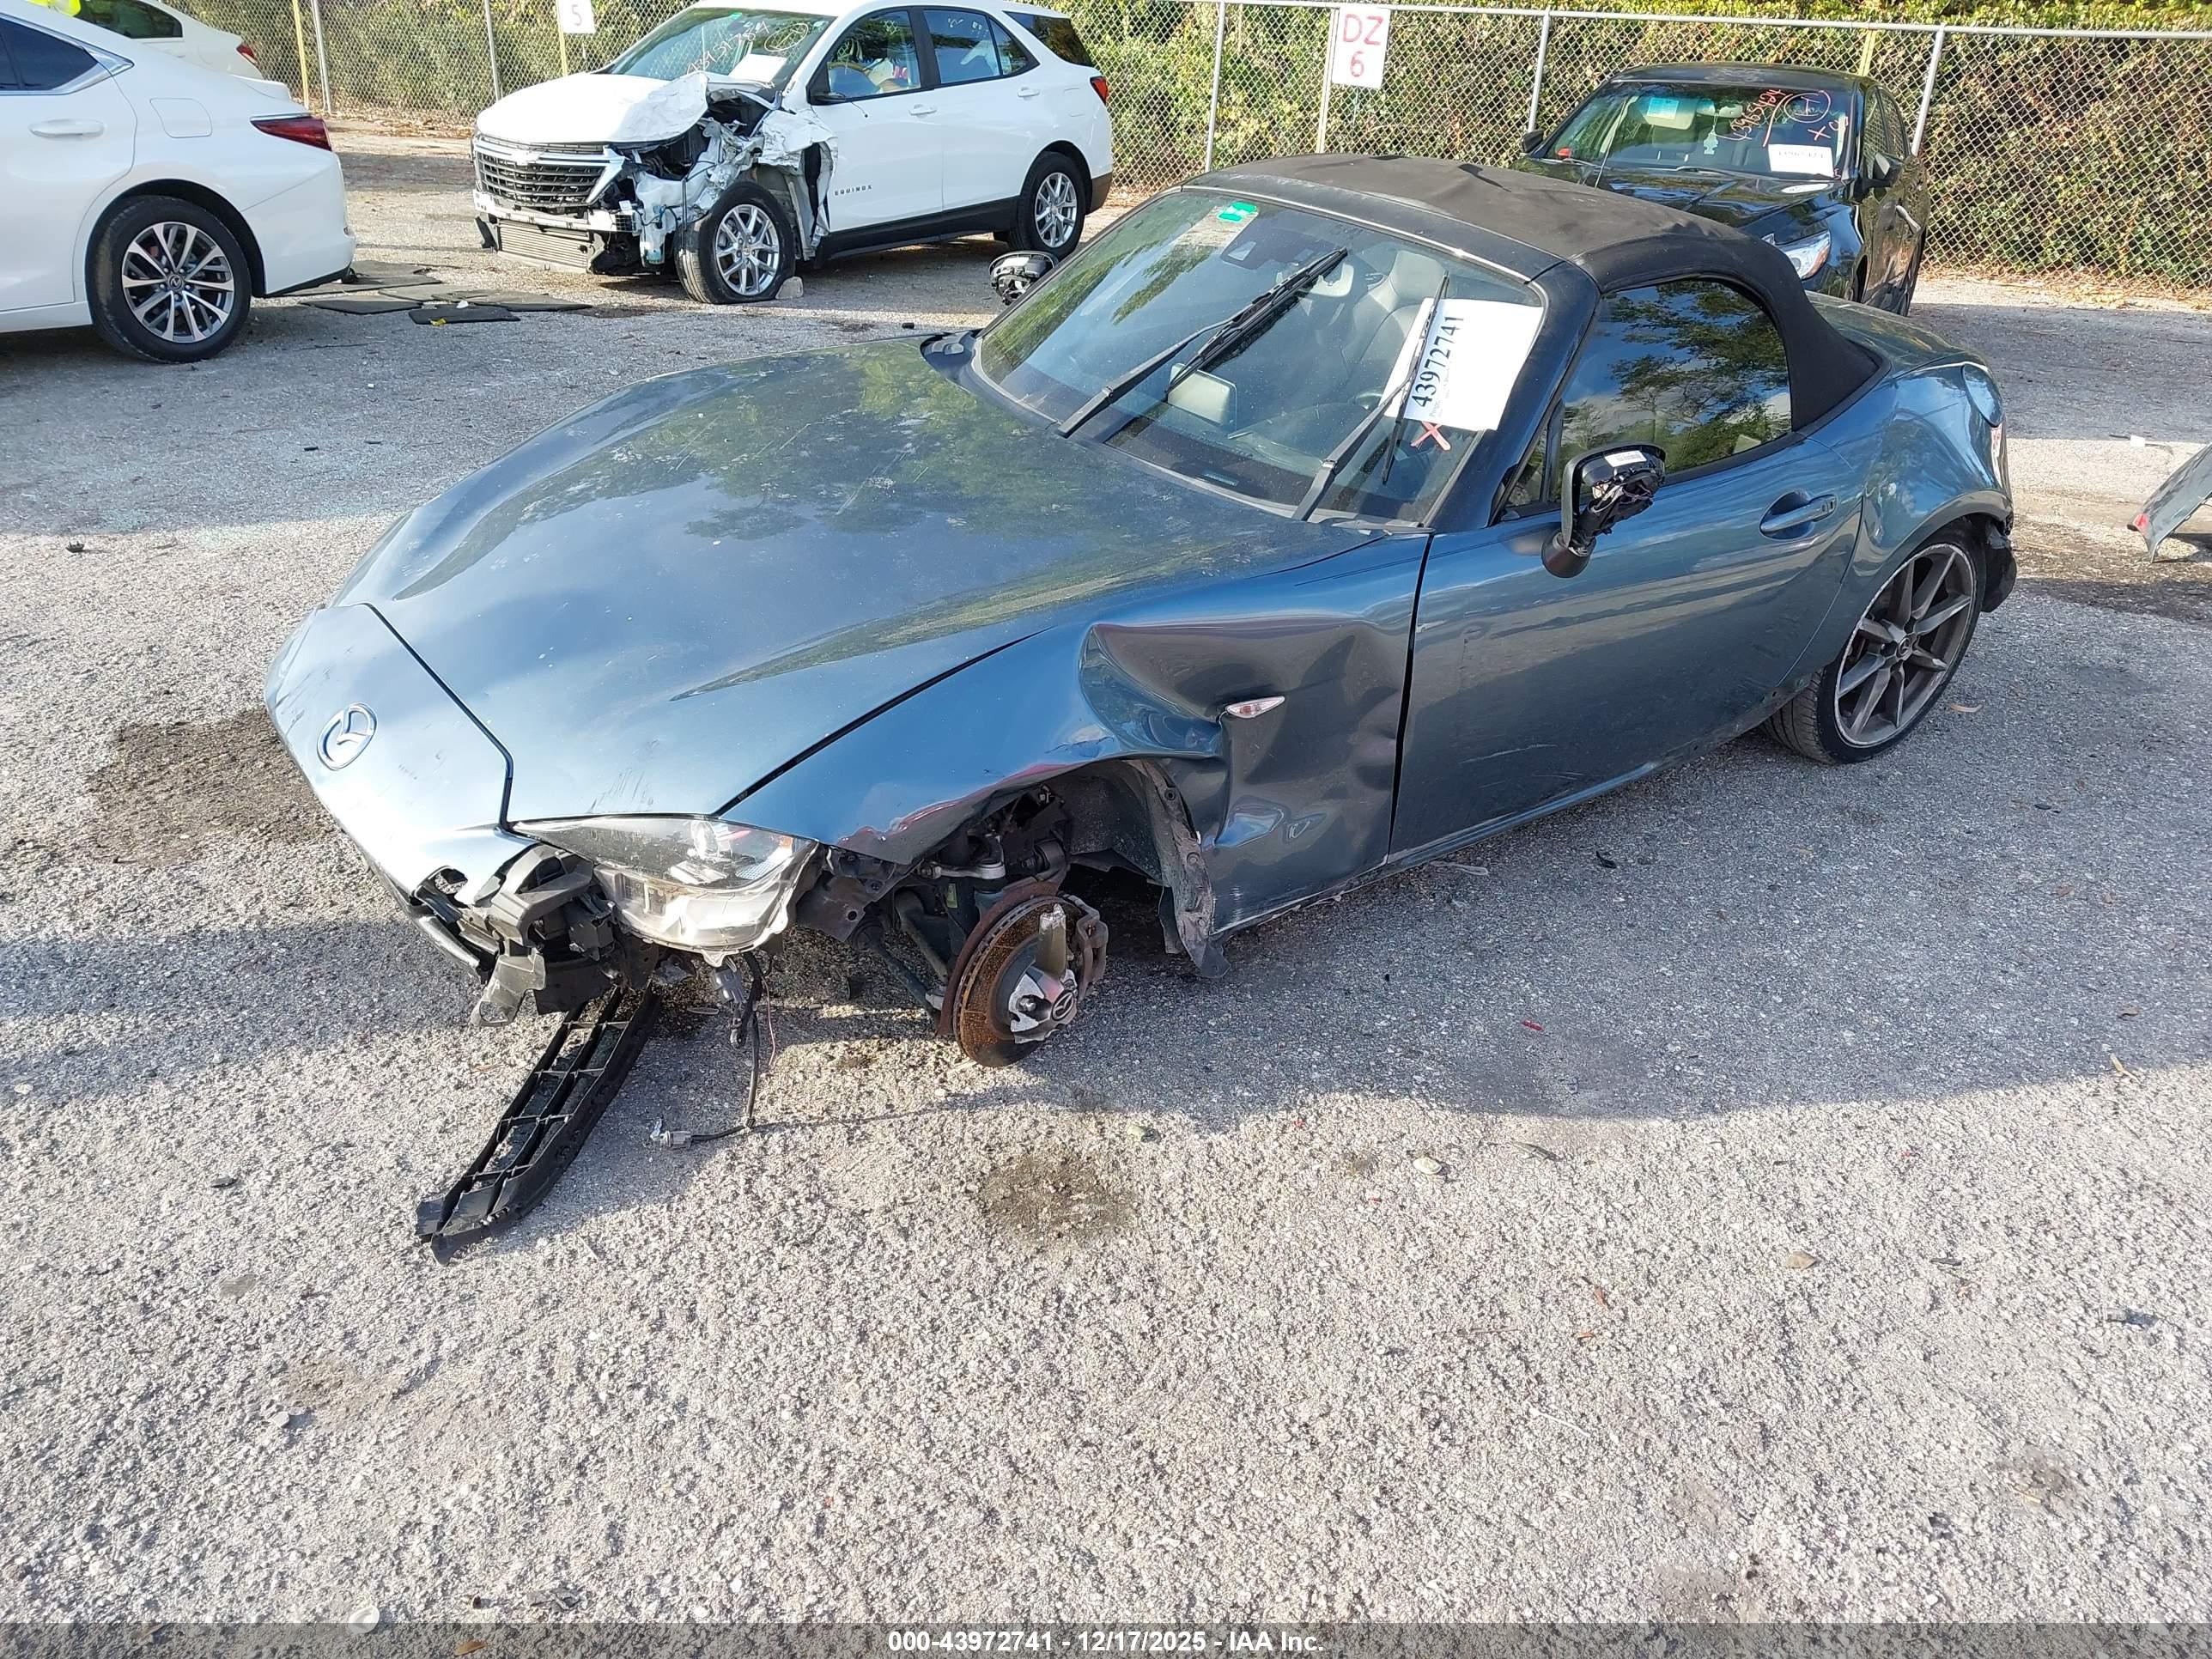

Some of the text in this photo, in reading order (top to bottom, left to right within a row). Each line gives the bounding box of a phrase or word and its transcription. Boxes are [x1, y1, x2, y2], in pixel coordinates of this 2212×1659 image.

[571, 4, 582, 27] 5
[1342, 13, 1384, 46] DZ
[1349, 51, 1364, 77] 6
[834, 184, 872, 196] EQUINOX
[1411, 316, 1464, 409] 43972741
